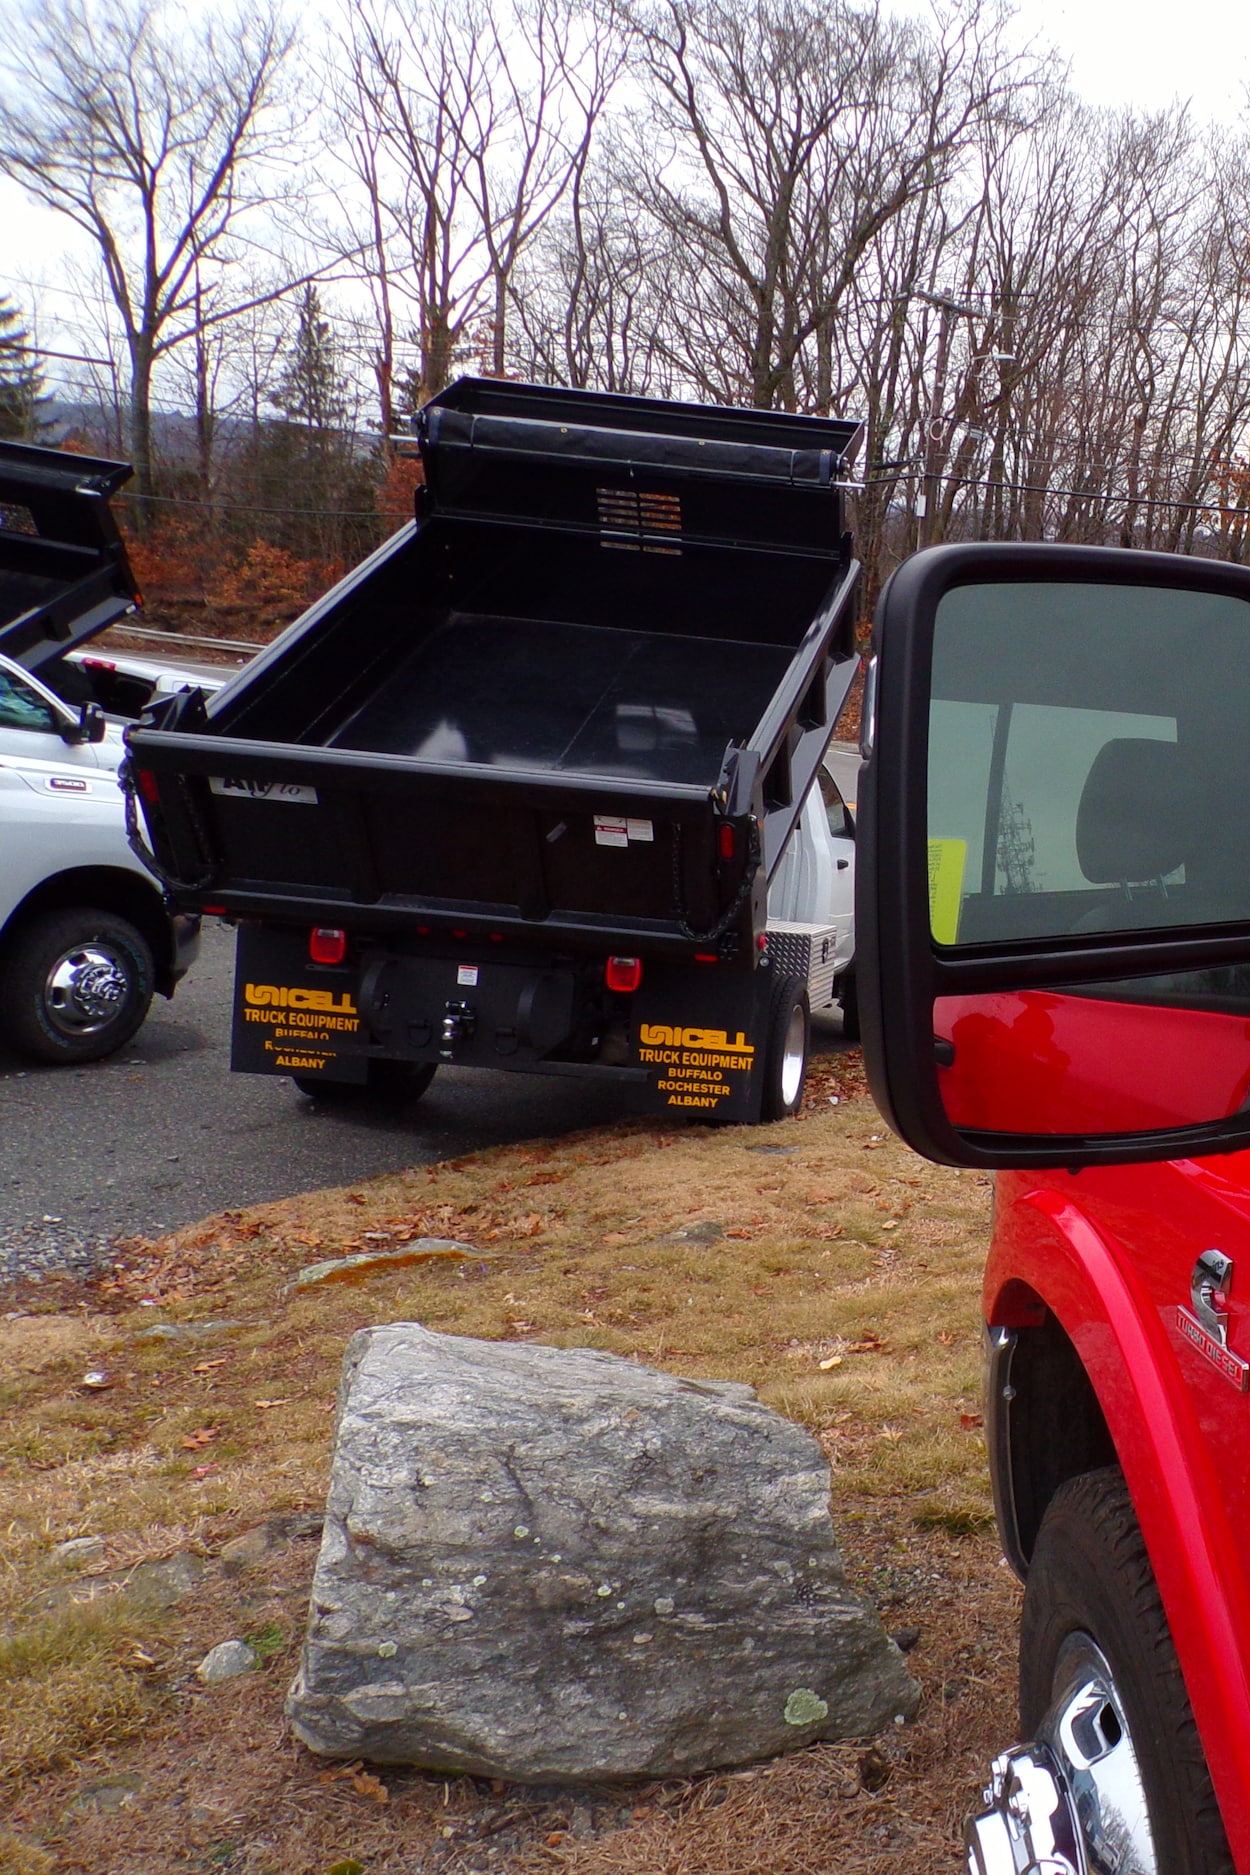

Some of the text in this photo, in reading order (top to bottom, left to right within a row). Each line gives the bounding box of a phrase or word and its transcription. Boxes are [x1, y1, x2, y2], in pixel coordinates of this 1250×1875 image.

[245, 983, 357, 1014] UNICELL
[244, 1008, 359, 1032] TRUCK EQUIPMENT
[640, 1024, 755, 1053] UNICELL
[275, 1055, 325, 1069] ALBANY
[639, 1049, 754, 1070] TRUCK EQUIPMENT
[668, 1067, 723, 1081] BUFFALO
[657, 1080, 731, 1095] ROCHESTER
[667, 1095, 718, 1108] ALBANY
